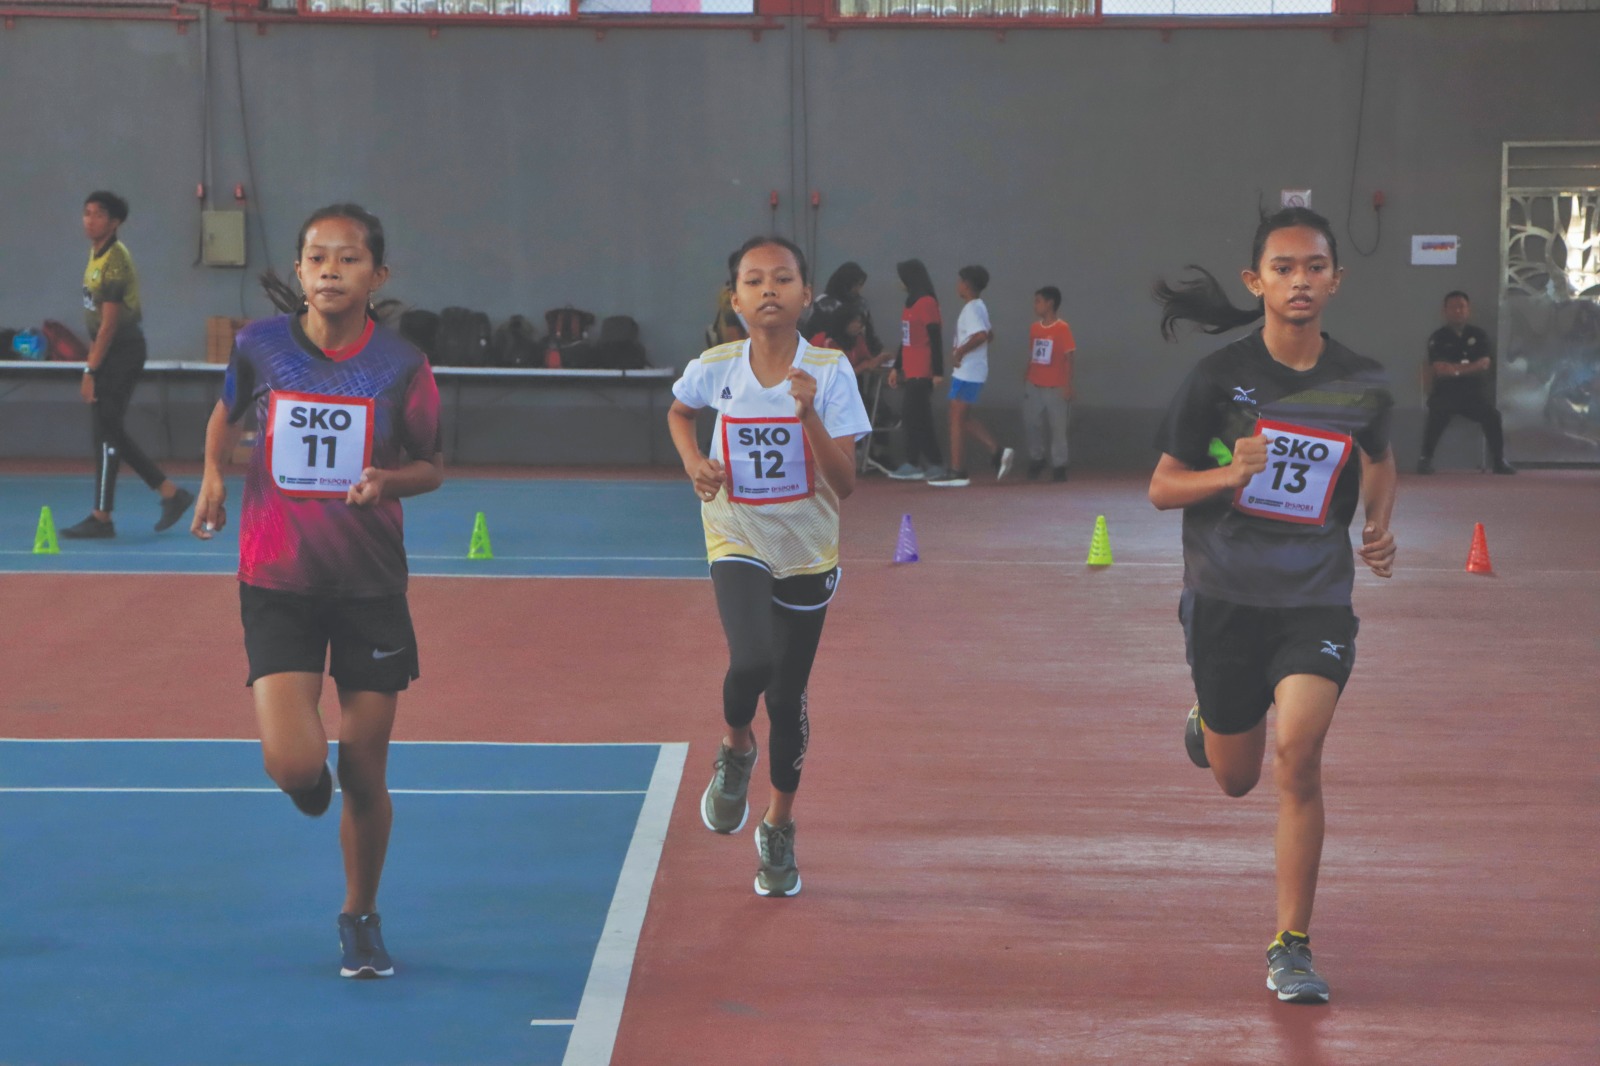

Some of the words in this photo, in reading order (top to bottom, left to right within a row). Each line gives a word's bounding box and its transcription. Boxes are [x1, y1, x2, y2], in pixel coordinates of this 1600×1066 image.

[289, 406, 352, 430] SKO
[738, 427, 791, 446] SKO
[1270, 436, 1329, 462] SKO
[301, 434, 337, 469] 11
[748, 450, 786, 479] 12
[1271, 461, 1311, 494] 13
